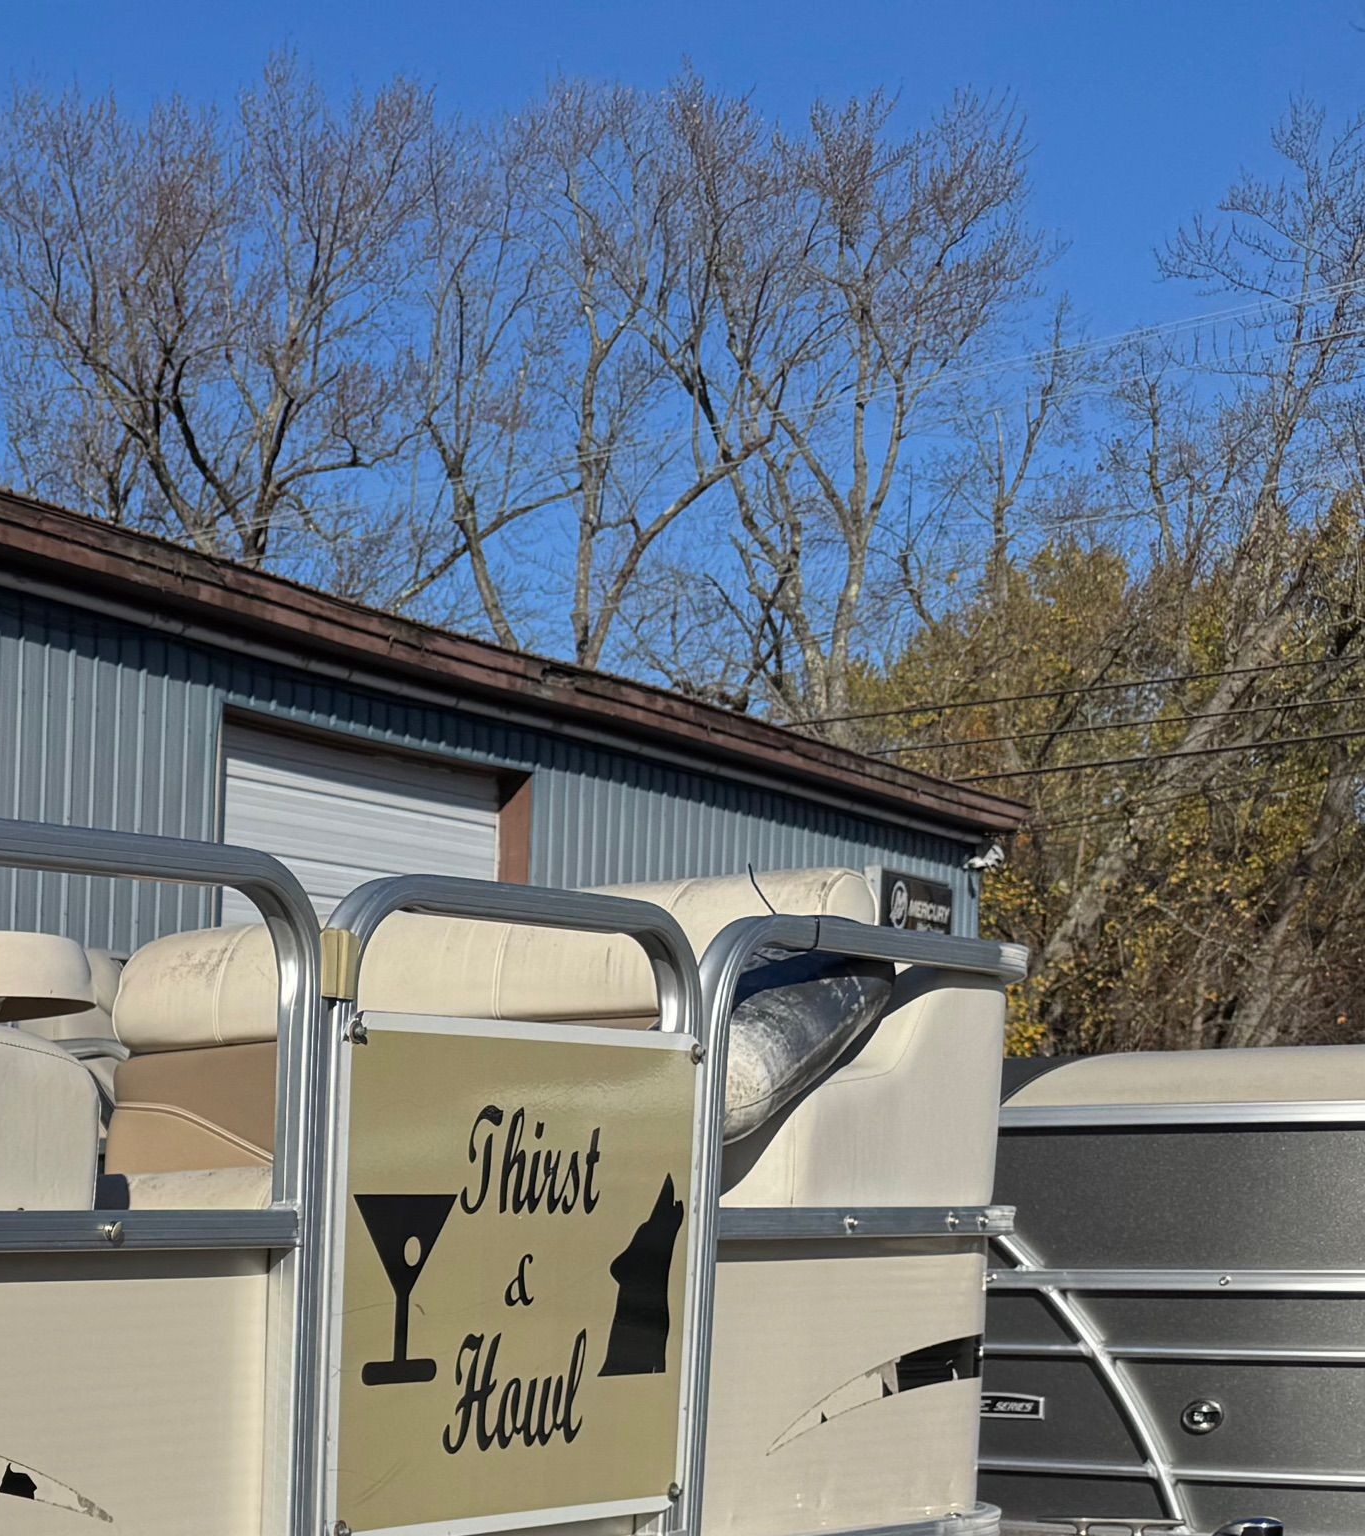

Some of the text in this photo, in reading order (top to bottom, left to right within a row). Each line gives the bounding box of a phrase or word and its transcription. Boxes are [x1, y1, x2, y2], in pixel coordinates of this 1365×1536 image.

[908, 899, 950, 924] MERCURY
[459, 1104, 602, 1215] Thirst
[504, 1253, 534, 1307] &
[442, 1328, 587, 1455] Howl
[992, 1401, 1034, 1412] SERIES
